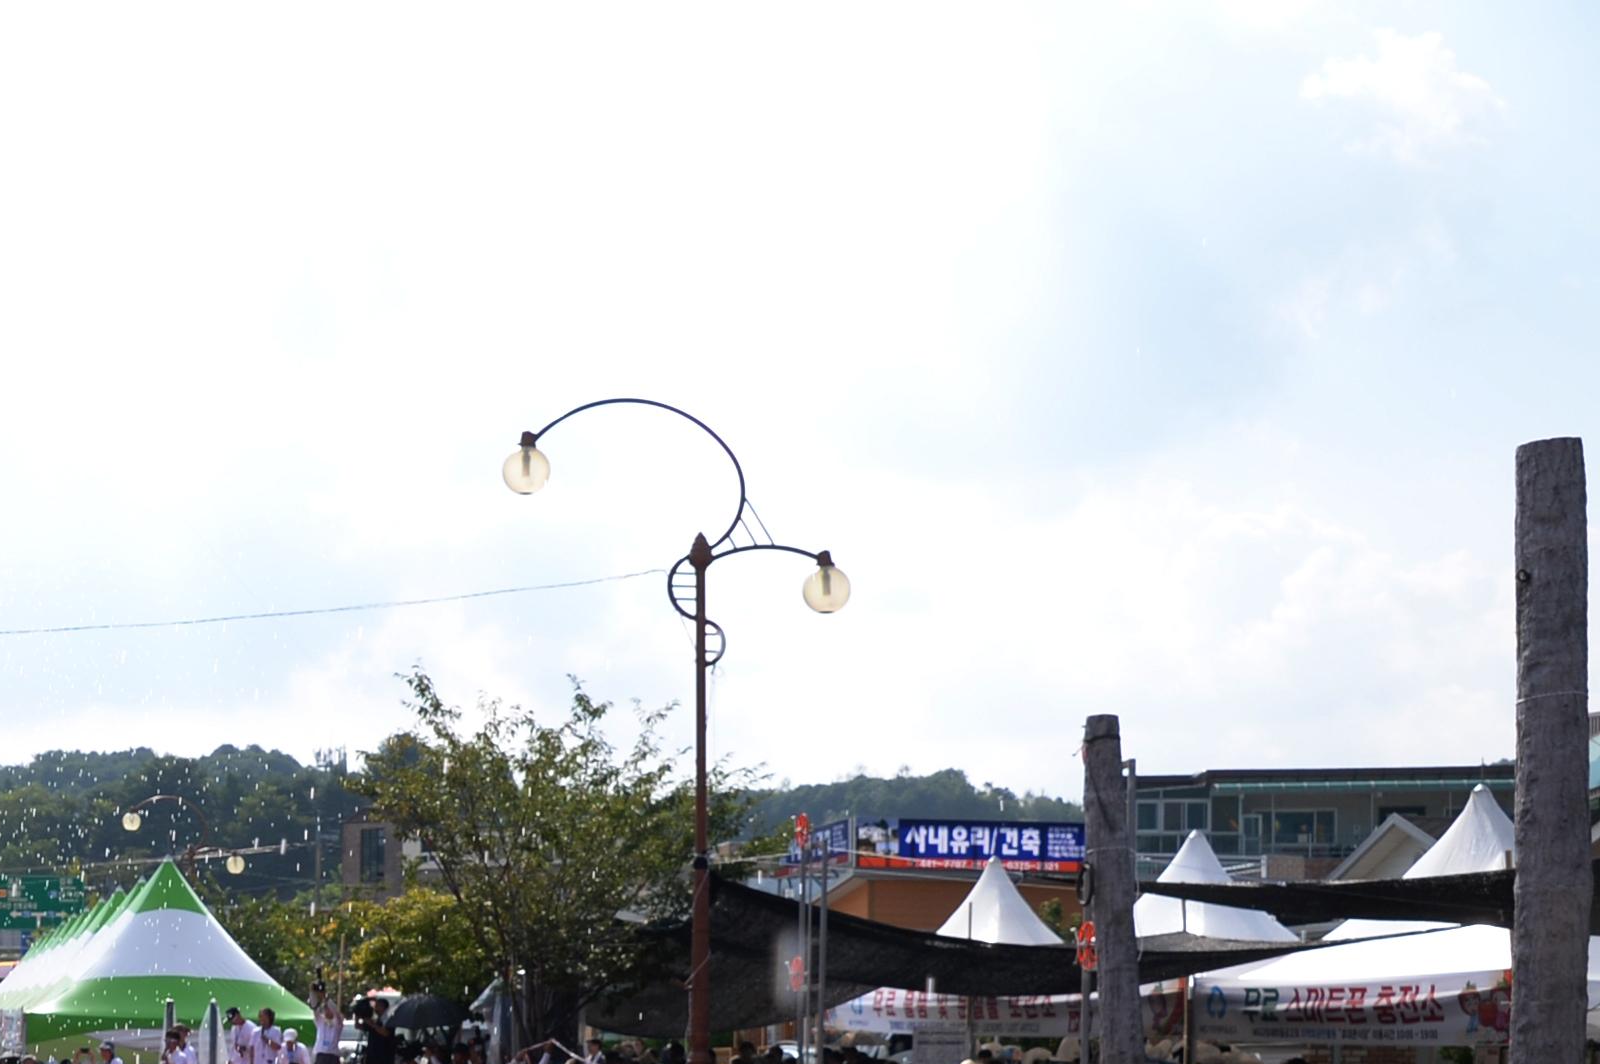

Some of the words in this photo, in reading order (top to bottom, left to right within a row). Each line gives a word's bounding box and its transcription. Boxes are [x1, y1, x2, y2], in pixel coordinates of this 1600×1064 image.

[905, 825, 1041, 856] 사내유리/건축
[1241, 987, 1280, 1024] 무료
[1285, 986, 1368, 1025] 스마트폰
[1373, 983, 1445, 1024] 충전소
